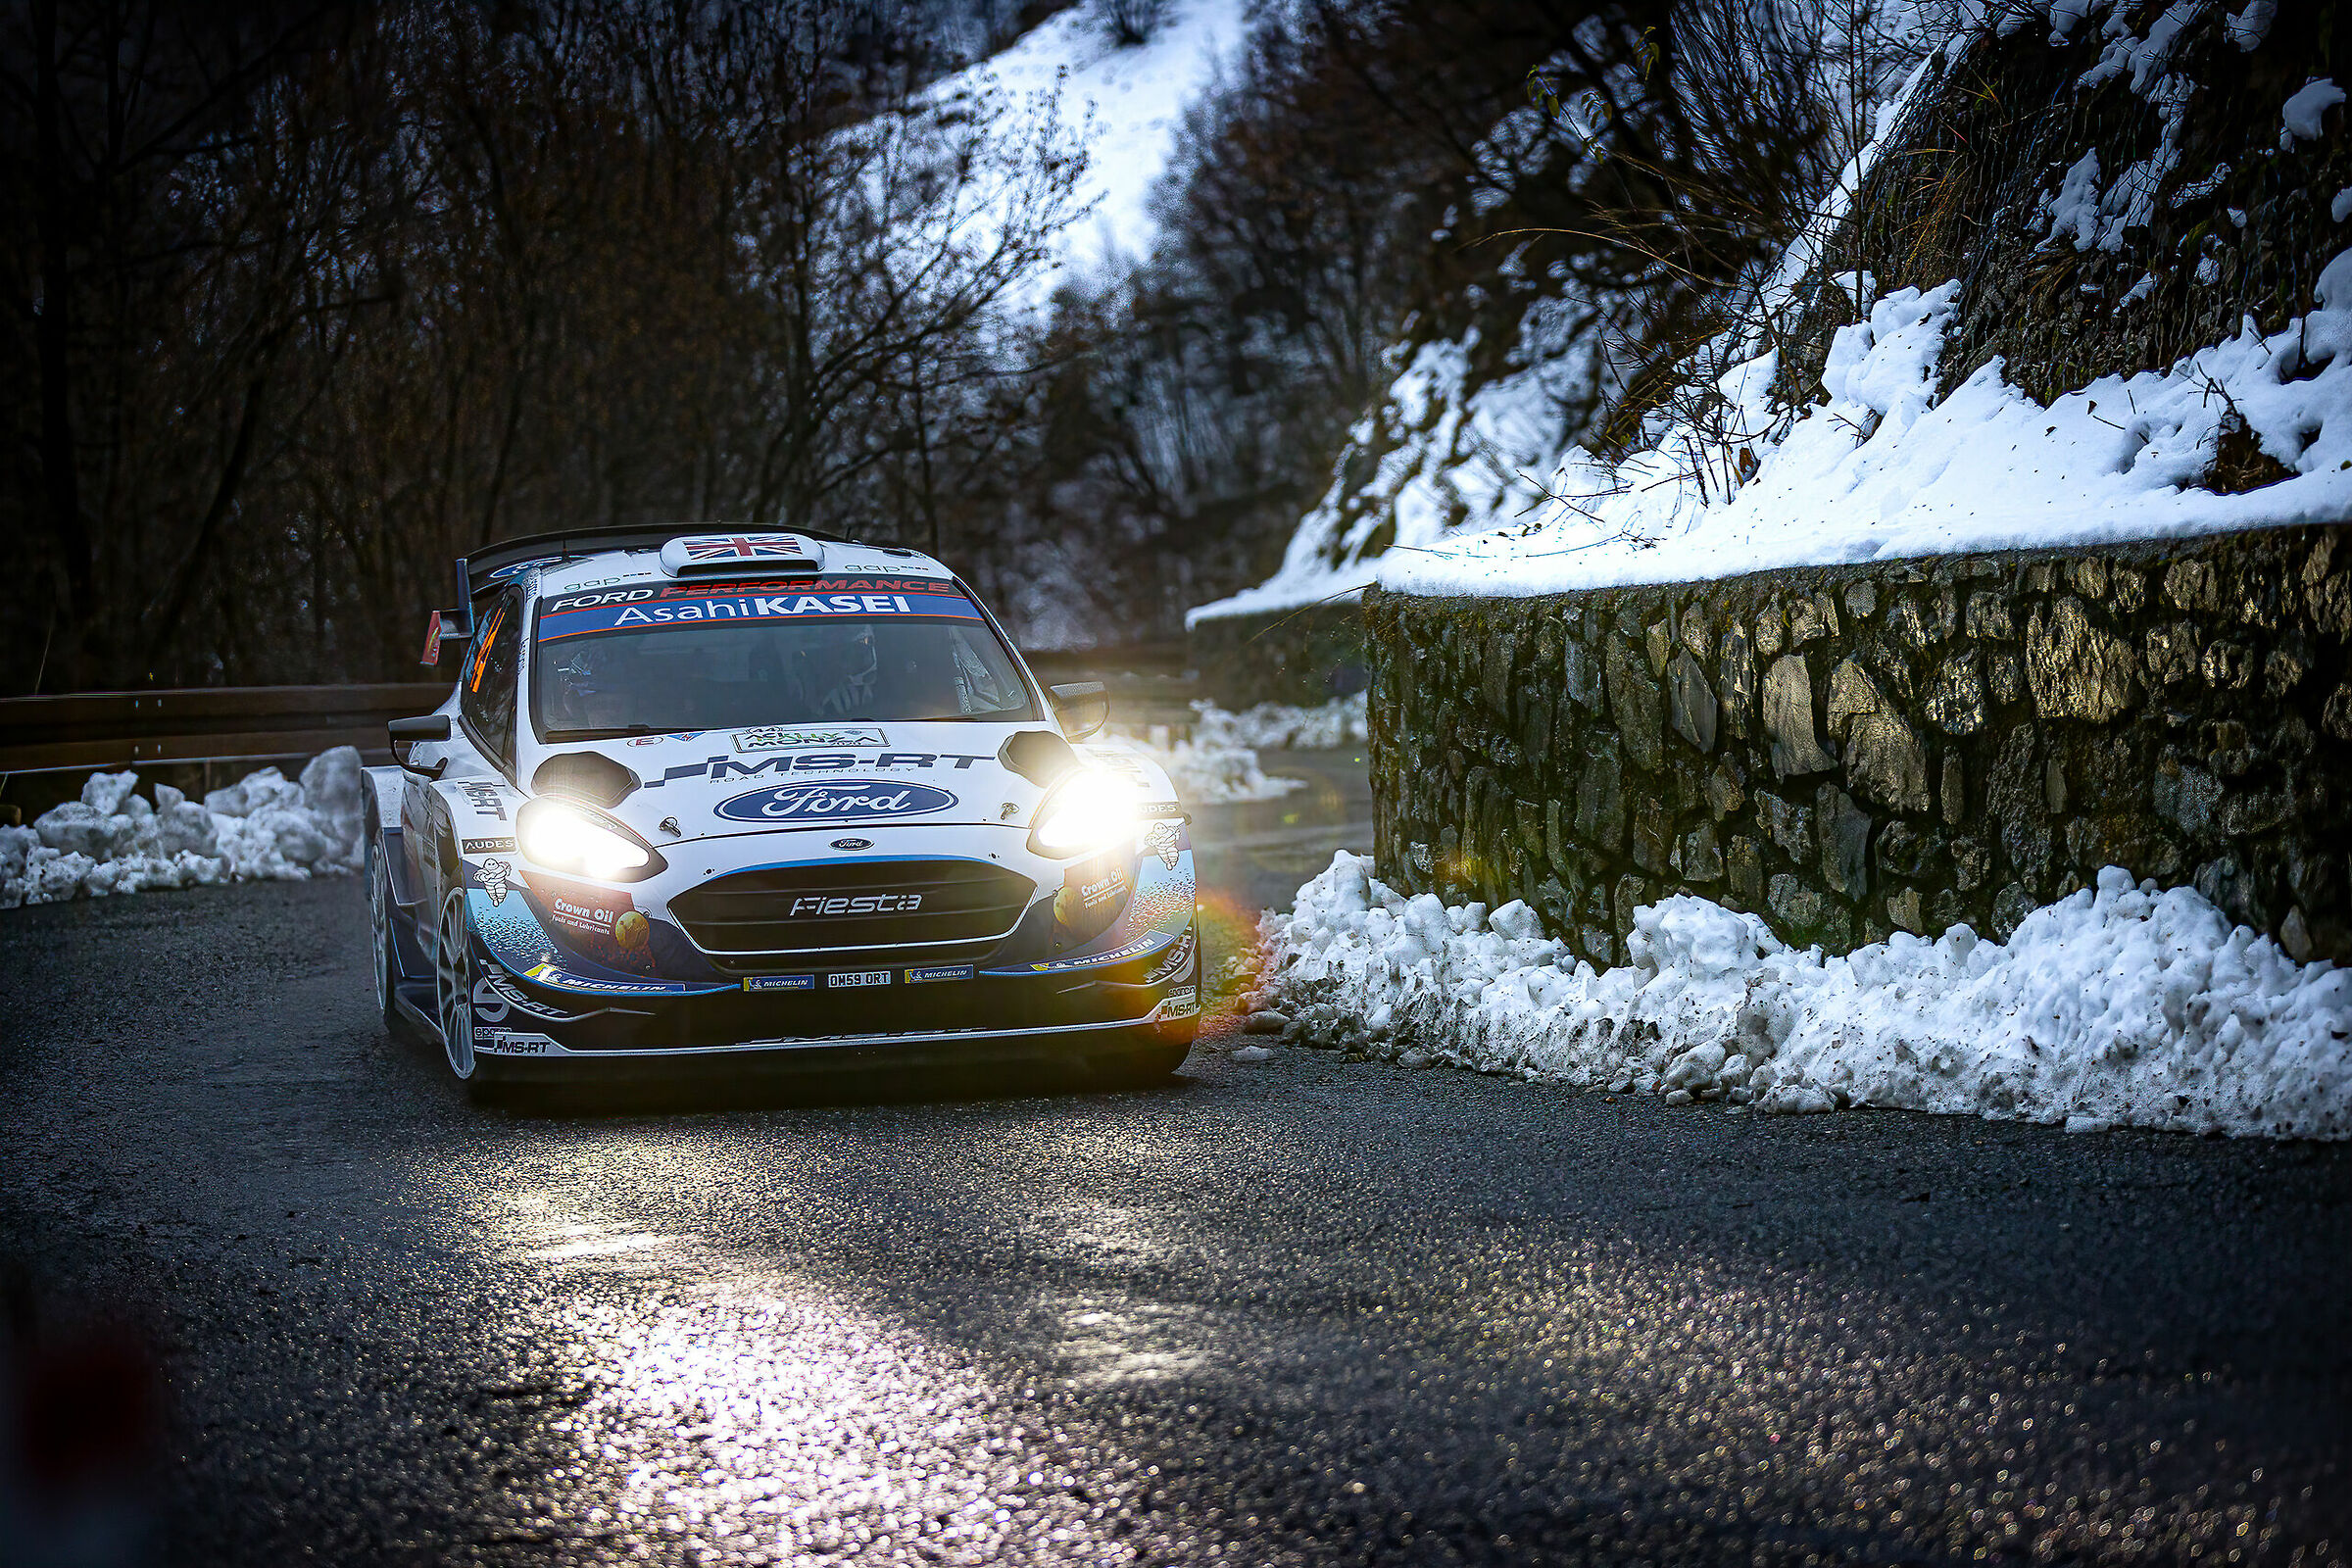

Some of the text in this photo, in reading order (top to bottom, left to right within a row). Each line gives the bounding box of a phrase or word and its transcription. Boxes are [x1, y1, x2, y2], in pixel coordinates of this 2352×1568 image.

[564, 577, 621, 591] gap
[551, 589, 655, 612] FORD
[660, 580, 950, 598] PERFORMANCE
[710, 753, 996, 779] MS-RT
[710, 767, 913, 784] ROAD TECHNOLOGY
[761, 782, 911, 816] Ford
[465, 840, 514, 850] AUDES
[839, 839, 863, 848] Ford
[1081, 878, 1109, 897] Crown
[555, 898, 614, 923] Crown Oil
[789, 894, 923, 916] Fiesta
[1073, 938, 1156, 966] MICHELIN
[924, 970, 968, 979] MICHELIN
[563, 978, 667, 991] MICHELIN
